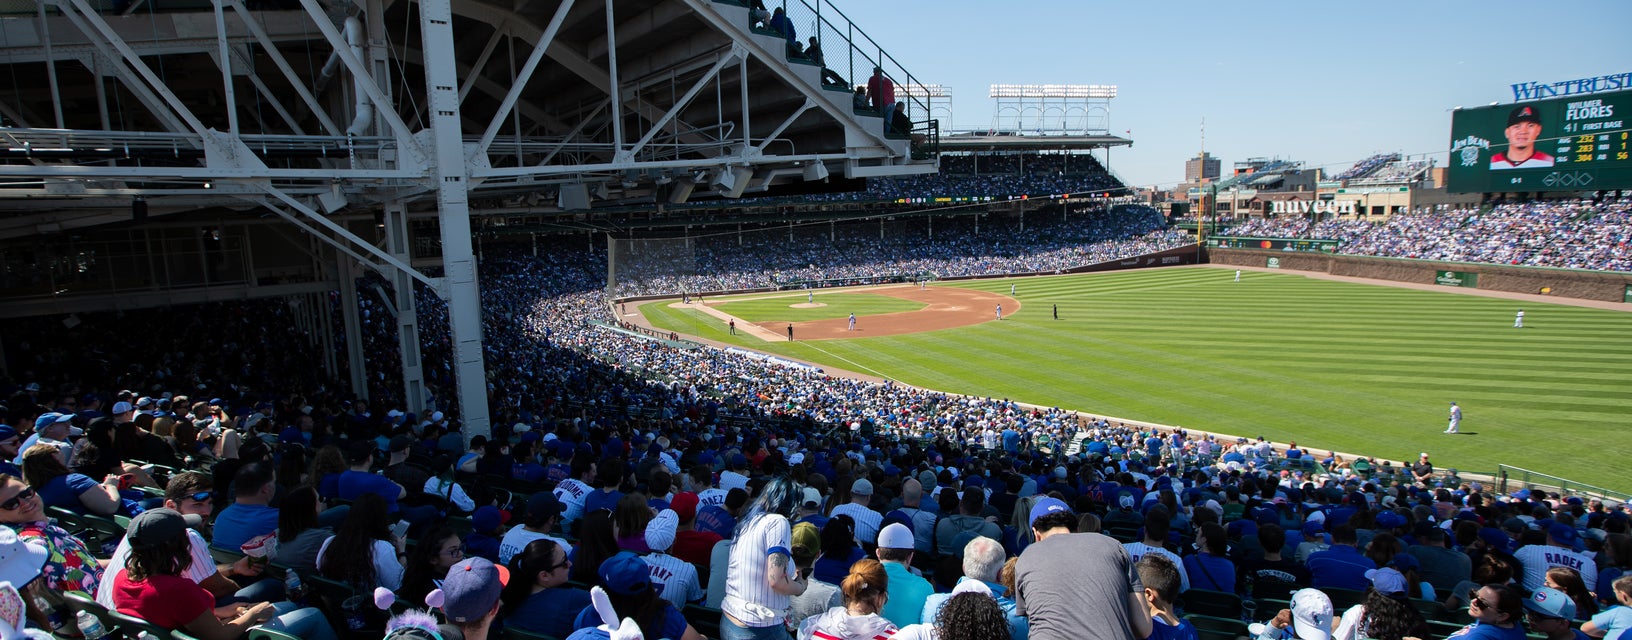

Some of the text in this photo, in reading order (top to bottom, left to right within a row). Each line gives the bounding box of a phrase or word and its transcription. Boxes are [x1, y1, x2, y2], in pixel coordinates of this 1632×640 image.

[1510, 72, 1632, 102] WINTRUST
[1567, 99, 1602, 109] WILMER
[1566, 105, 1614, 121] FLORES
[1564, 120, 1623, 132] 41 FIRST BASE
[1450, 135, 1490, 153] JIM BEAM
[1620, 142, 1627, 150] 1
[1616, 151, 1629, 160] 56
[1271, 199, 1356, 214] nuveen
[500, 543, 521, 556] CHIC
[1544, 552, 1584, 571] RADEK
[648, 565, 673, 581] YANT
